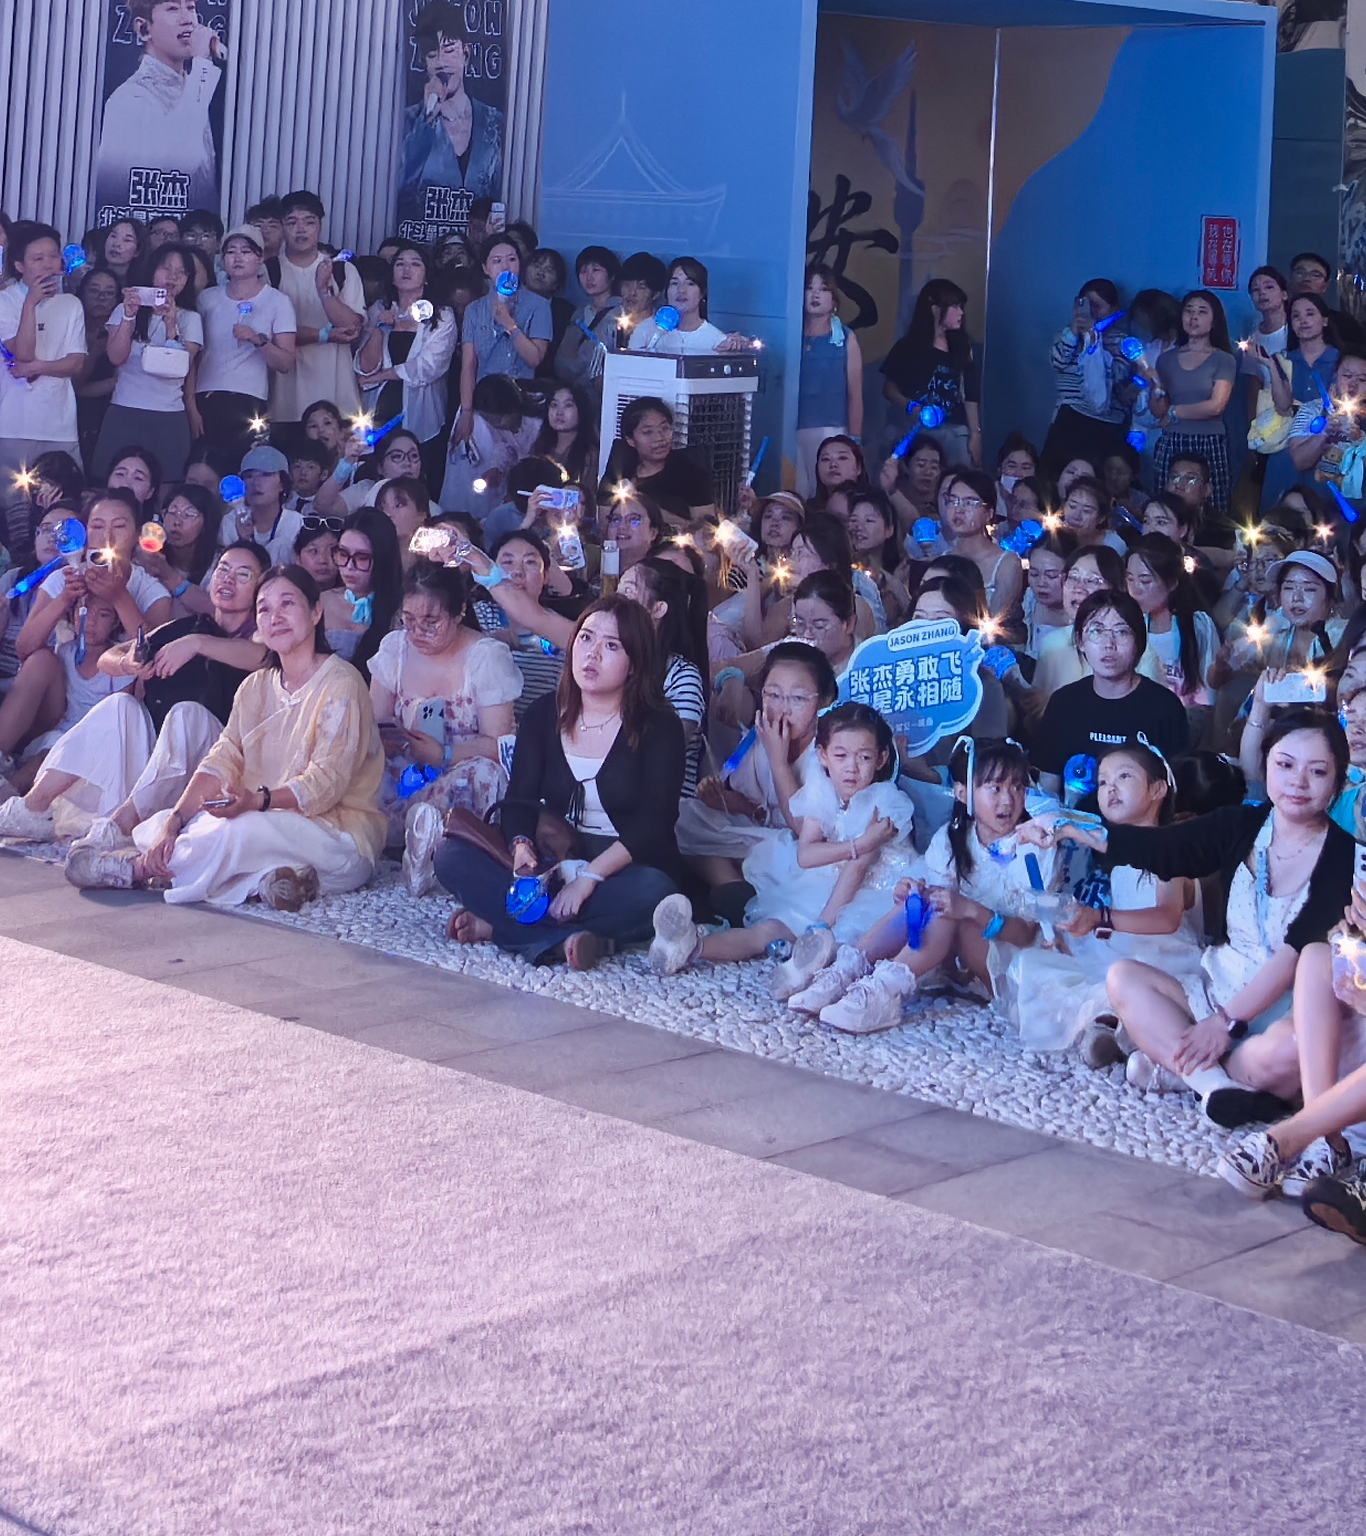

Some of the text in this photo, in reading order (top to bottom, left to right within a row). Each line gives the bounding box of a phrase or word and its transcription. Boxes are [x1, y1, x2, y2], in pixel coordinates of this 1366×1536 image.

[129, 168, 191, 209] 张杰
[889, 625, 955, 648] JASON ZHANG
[849, 651, 963, 696] 张杰勇敢飞
